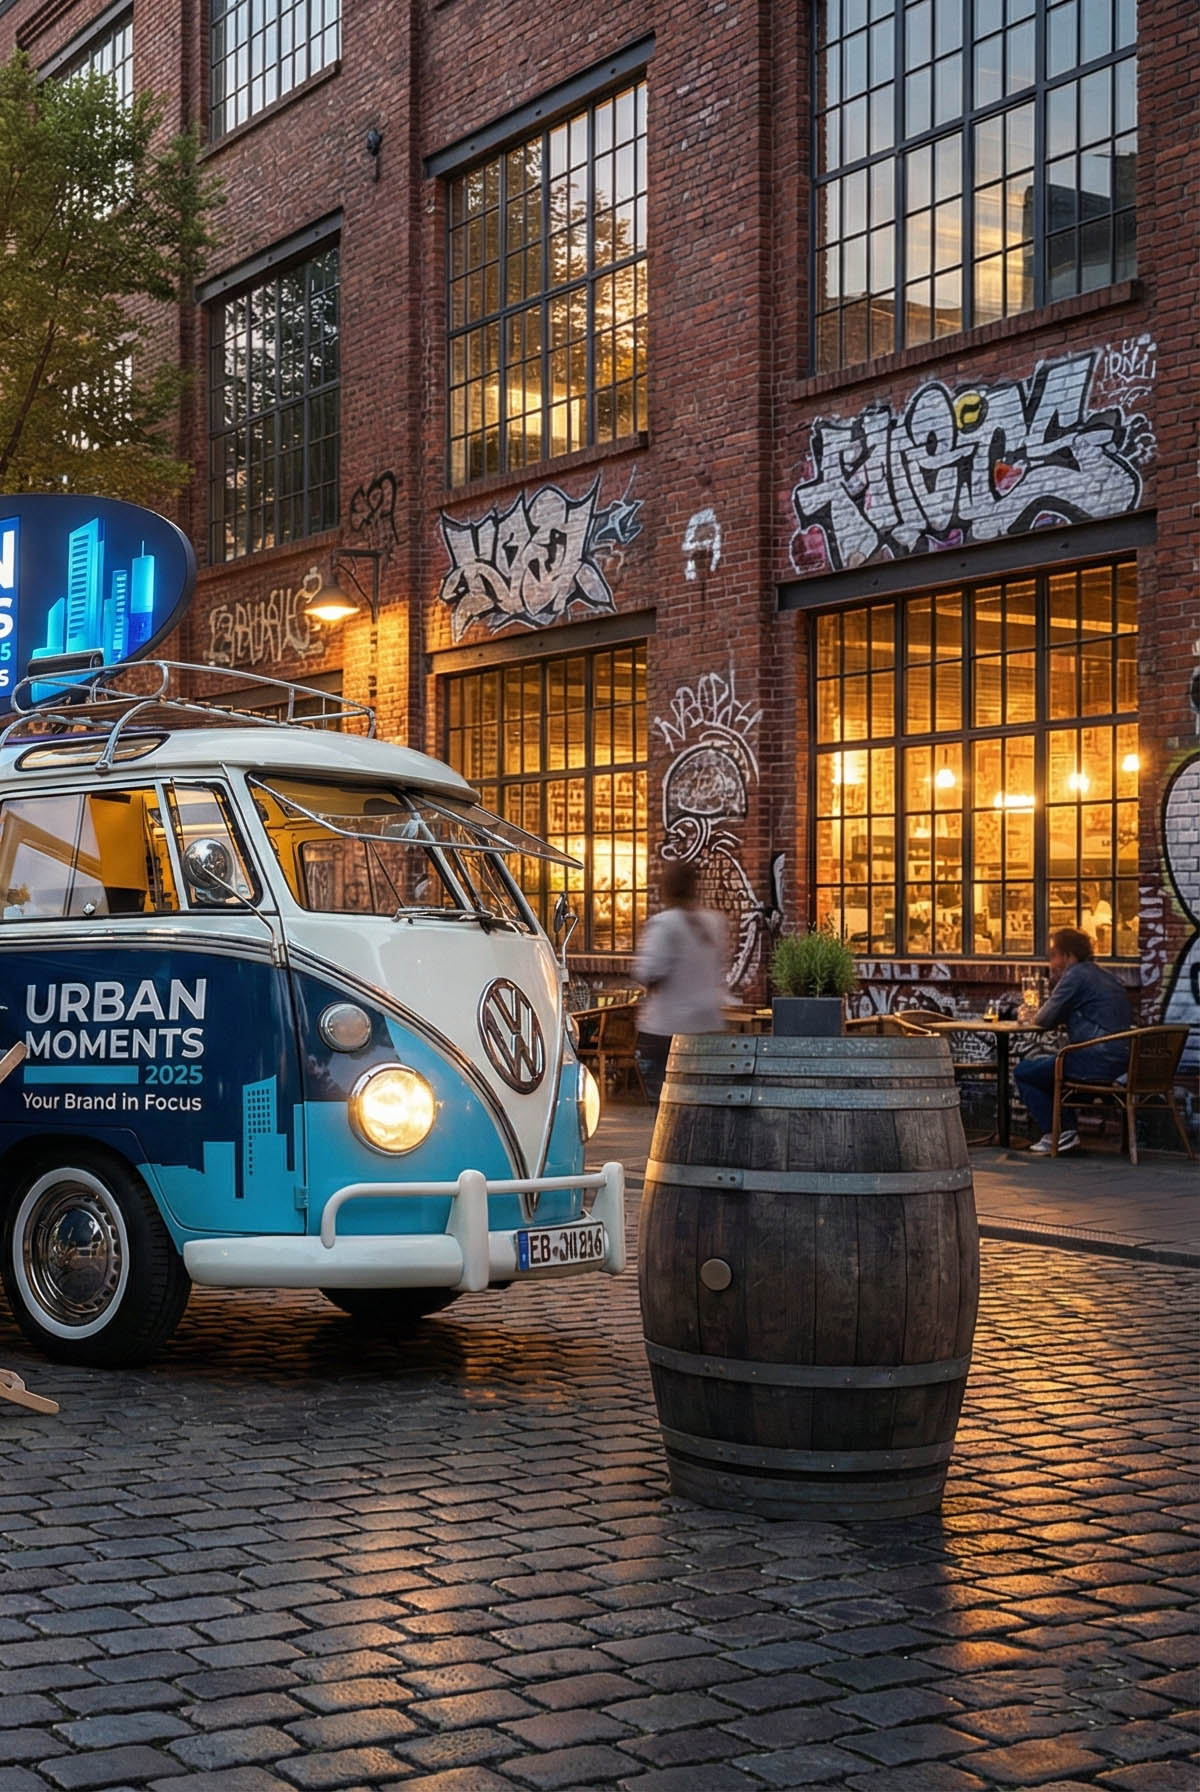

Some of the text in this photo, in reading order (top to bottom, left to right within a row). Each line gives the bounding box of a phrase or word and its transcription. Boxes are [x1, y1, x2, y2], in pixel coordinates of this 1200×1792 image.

[26, 978, 207, 1024] URBAN
[26, 1028, 204, 1059] MOMENTS
[477, 977, 545, 1094] VW
[145, 1065, 203, 1085] 2025
[23, 1092, 202, 1111] Your Brand in Focus
